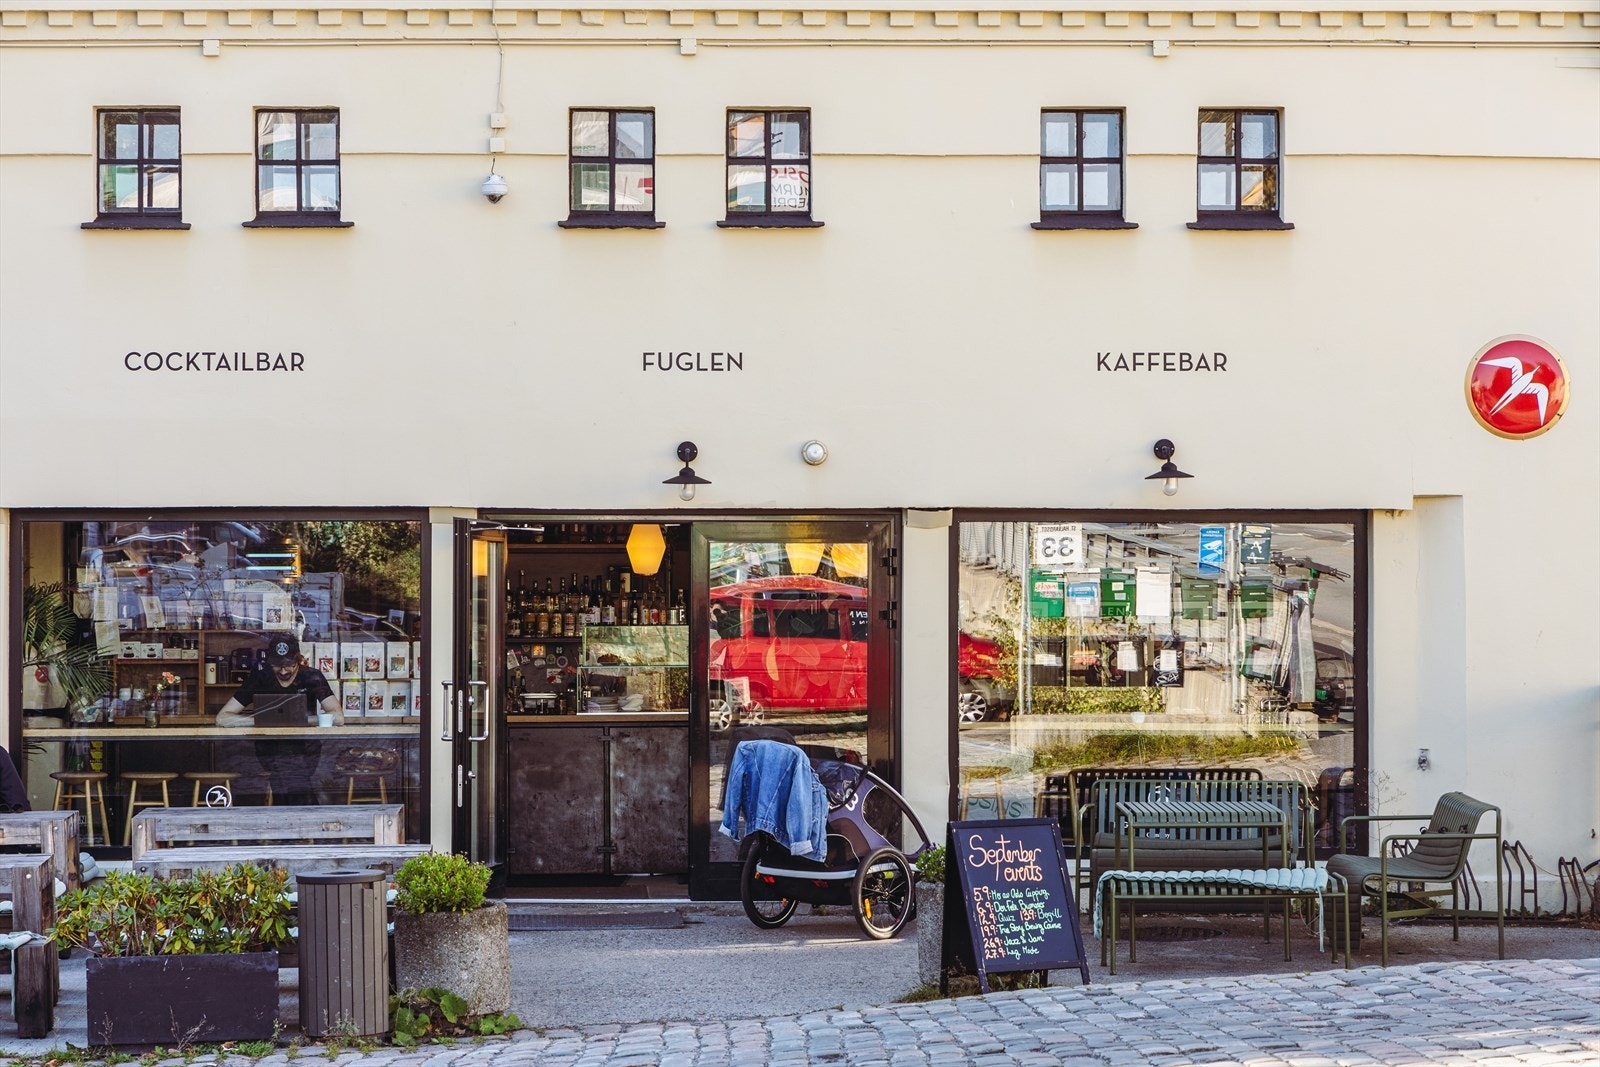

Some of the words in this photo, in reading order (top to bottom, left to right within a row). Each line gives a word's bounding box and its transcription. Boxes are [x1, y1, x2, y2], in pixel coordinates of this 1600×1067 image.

[124, 351, 305, 372] COCKTAILBAR
[642, 351, 743, 372] FUGLEN
[1096, 351, 1228, 372] KAFFEBAR
[968, 834, 1042, 882] September
[1004, 861, 1043, 882] events
